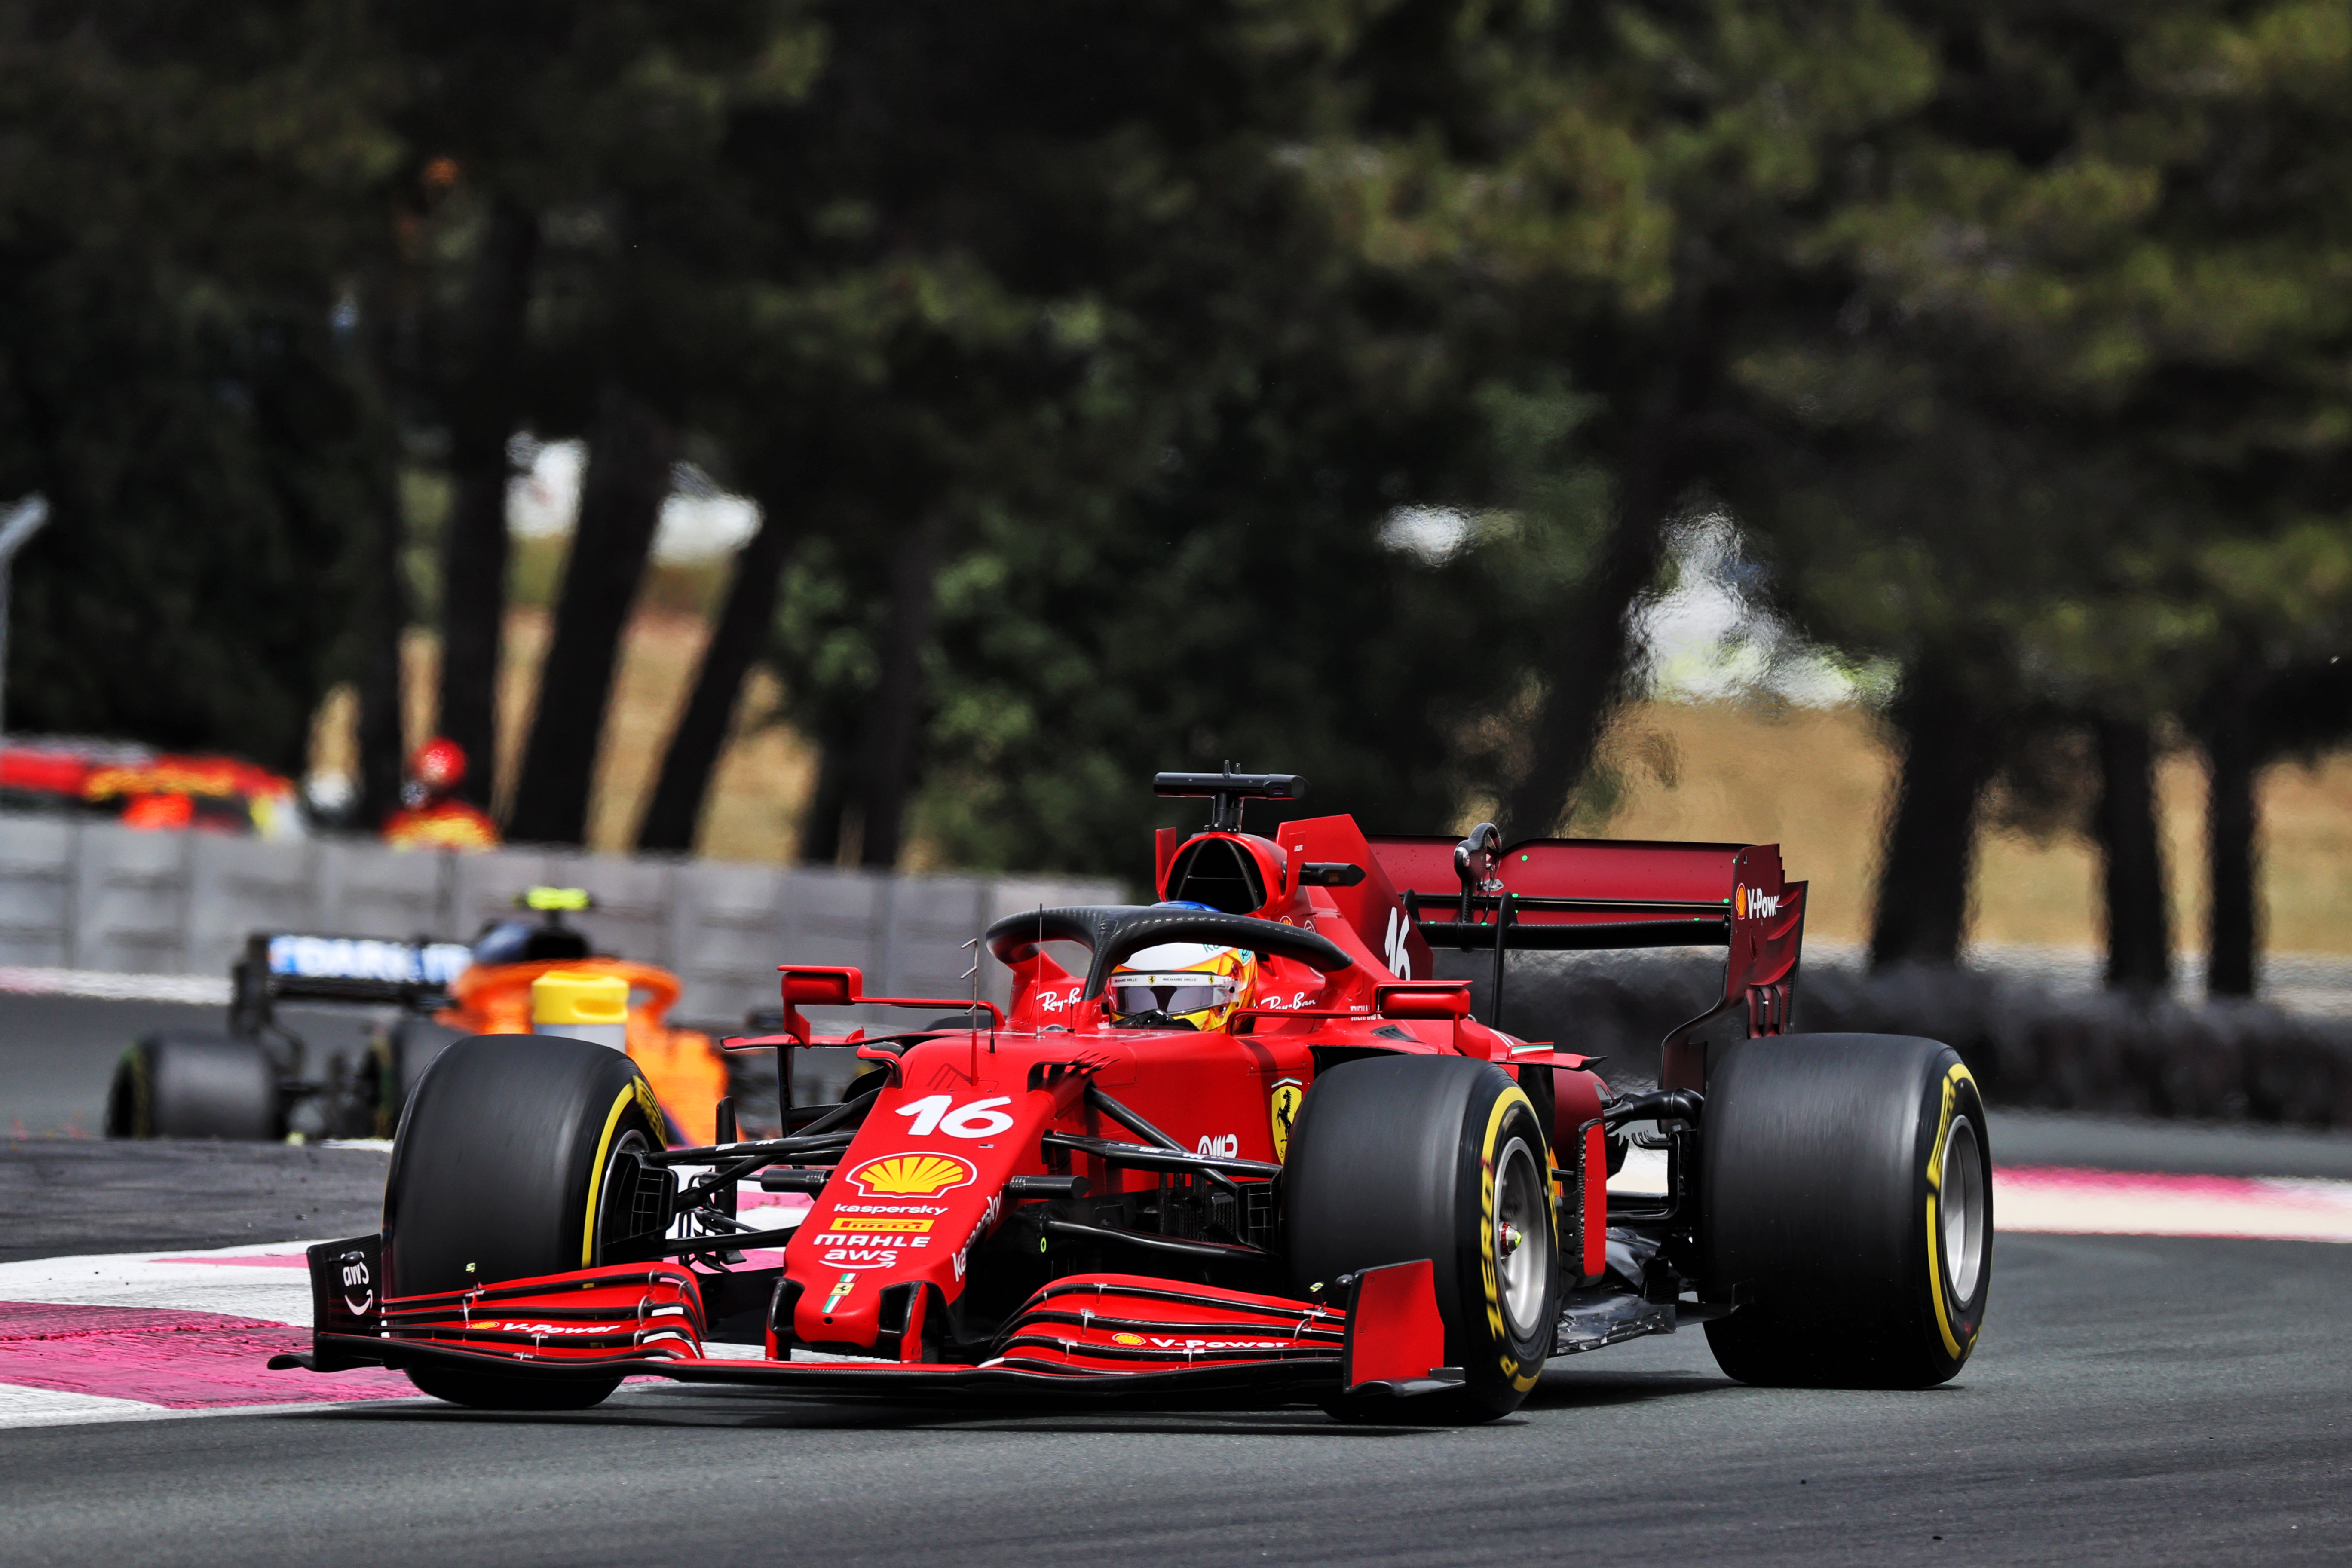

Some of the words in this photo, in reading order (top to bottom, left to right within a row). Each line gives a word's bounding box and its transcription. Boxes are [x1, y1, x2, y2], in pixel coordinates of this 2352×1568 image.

[895, 1095, 1014, 1139] 16
[834, 1204, 949, 1216] kaspersky
[840, 1221, 924, 1230] PIRELLI
[813, 1234, 931, 1247] MAHLE
[824, 1249, 898, 1262] aws
[1481, 1164, 1504, 1341] ZERO
[503, 1323, 621, 1333] V-Power
[1150, 1338, 1289, 1348] V-Power
